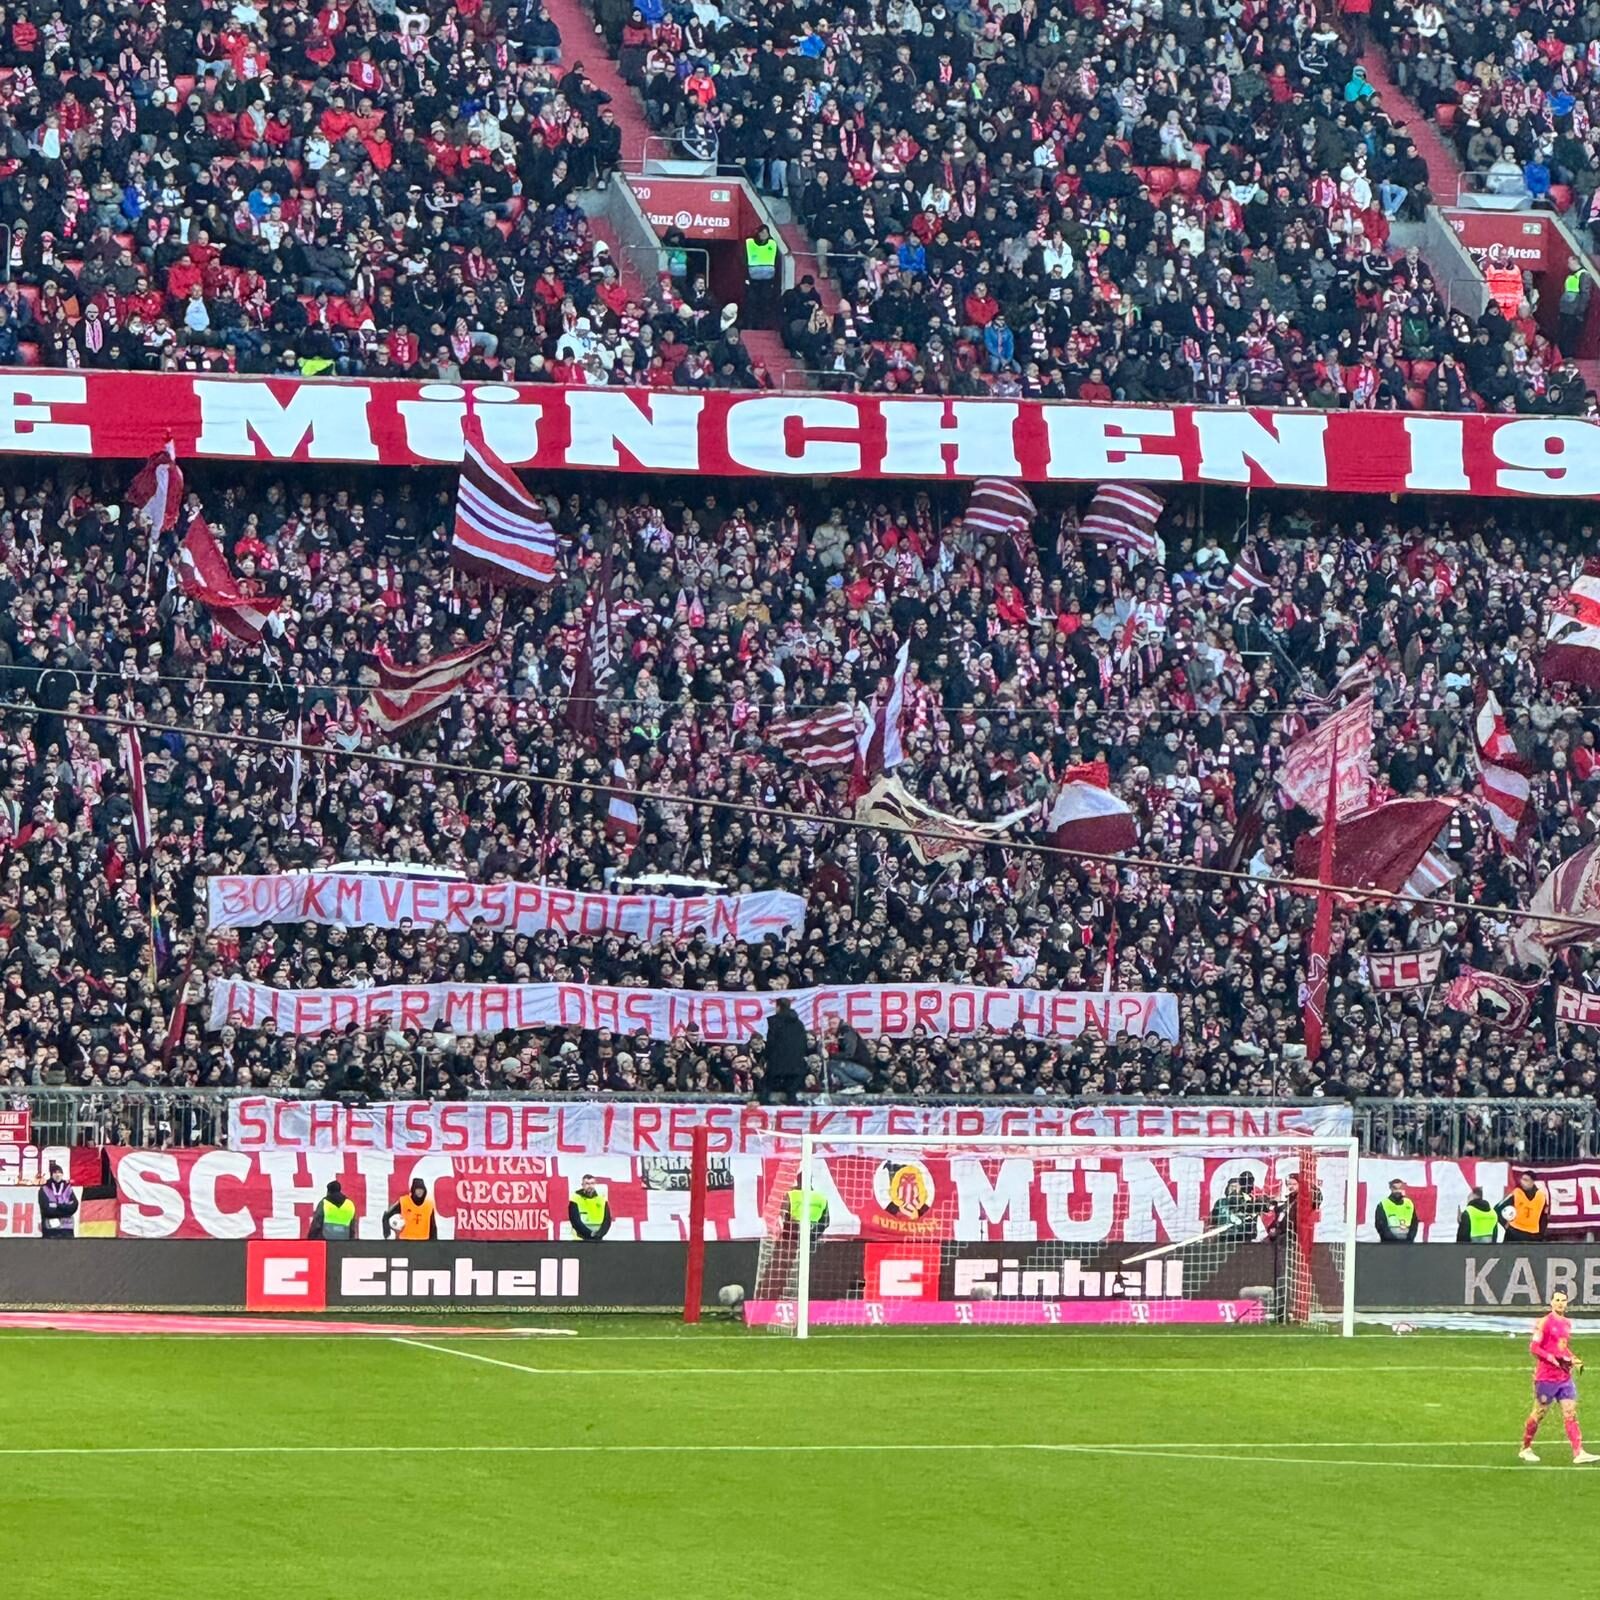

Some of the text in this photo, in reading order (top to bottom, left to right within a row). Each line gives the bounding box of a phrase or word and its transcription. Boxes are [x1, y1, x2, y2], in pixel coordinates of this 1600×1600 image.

[694, 213, 730, 227] Arena
[1508, 246, 1541, 259] Arena
[193, 378, 1328, 488] MÜNCHEN
[445, 986, 546, 1032] MAL
[558, 986, 654, 1036] DAS
[669, 995, 797, 1040] WOR
[239, 1099, 469, 1151] SCHEISS
[454, 1156, 547, 1175] ULTRAS
[456, 1179, 549, 1205] GEGEN
[457, 1208, 550, 1232] RASSISMUS
[341, 1257, 579, 1297] Einhell
[953, 1259, 1184, 1297] Einhell
[1464, 1257, 1600, 1305] KABE
